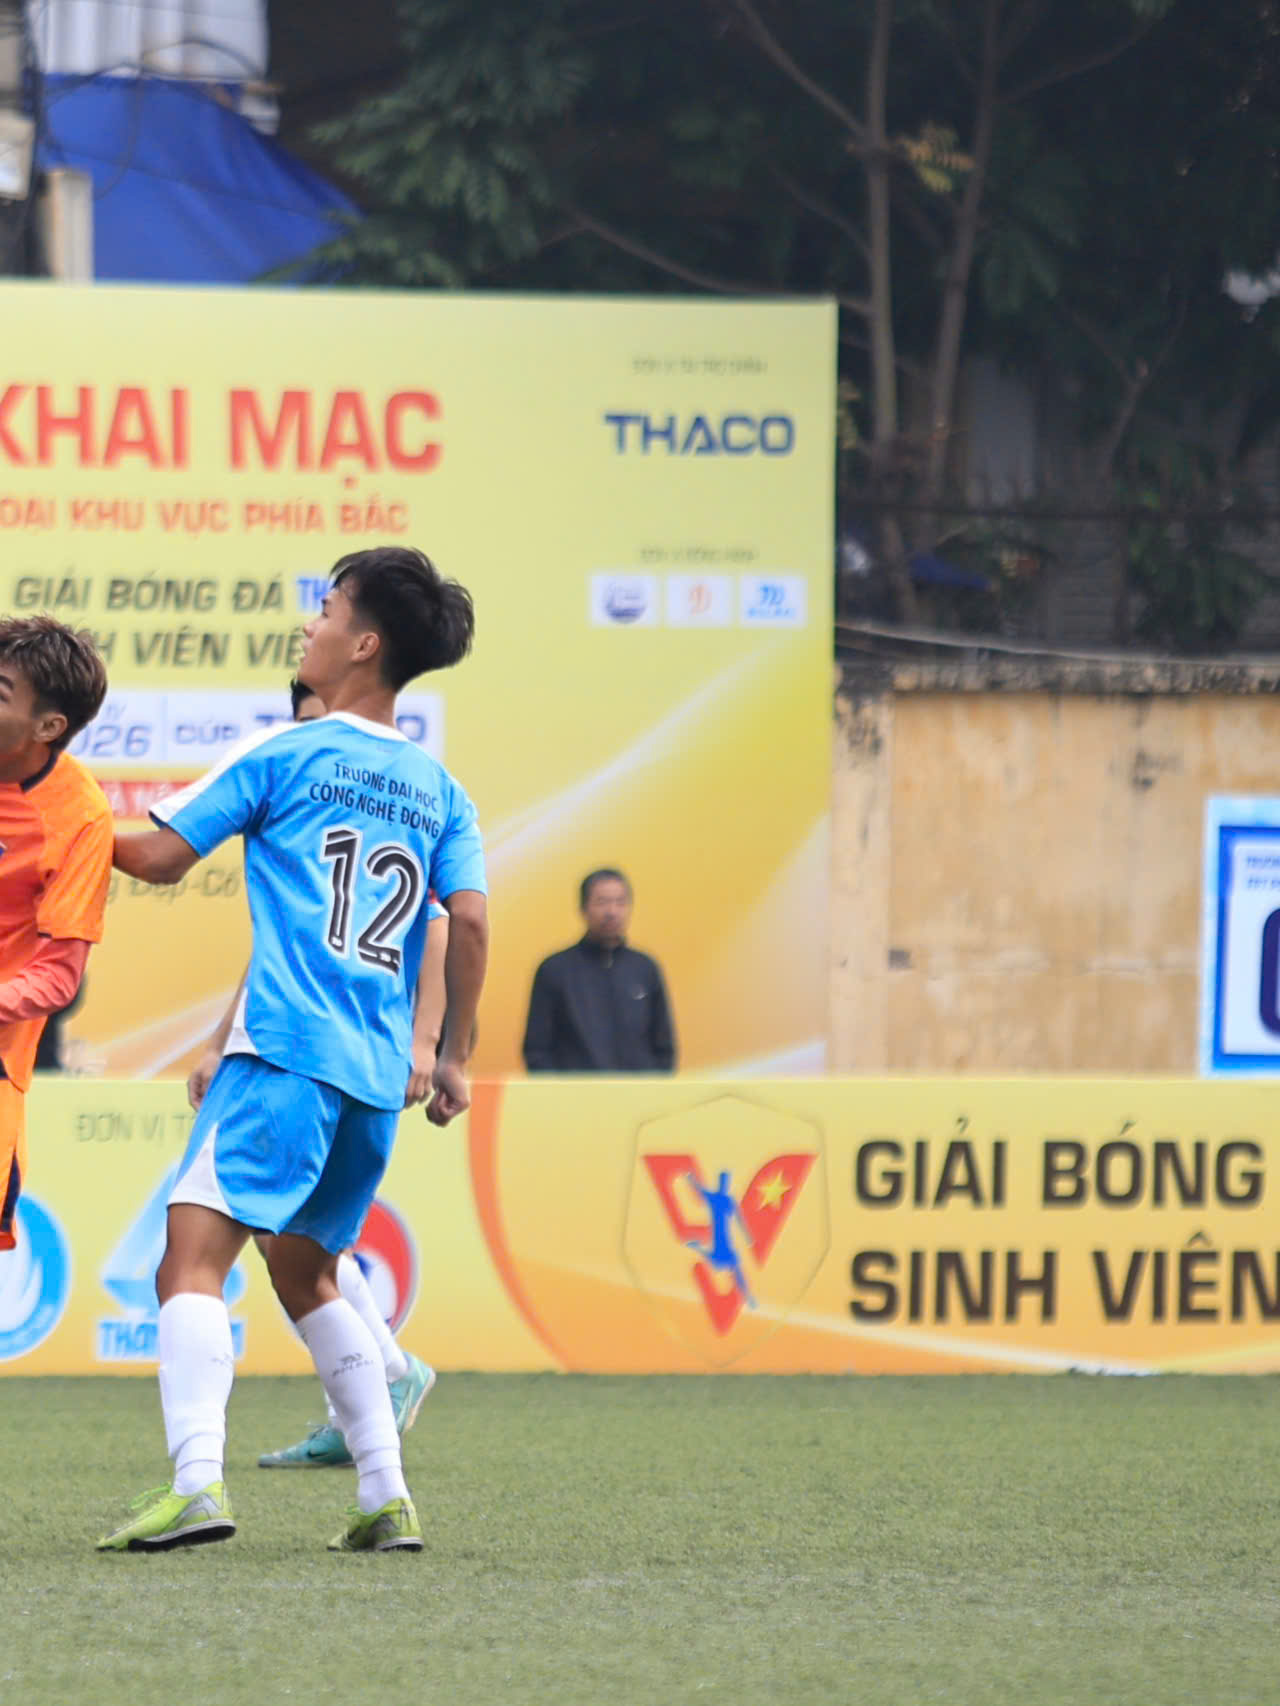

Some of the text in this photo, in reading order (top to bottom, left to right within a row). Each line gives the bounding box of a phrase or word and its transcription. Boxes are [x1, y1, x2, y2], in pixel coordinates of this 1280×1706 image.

[229, 388, 443, 490] MẠC
[604, 411, 796, 457] THACO
[71, 497, 145, 532] KHU
[244, 497, 326, 533] PHÍA
[106, 570, 218, 613] BÓNG
[232, 573, 284, 615] ĐÁ
[132, 625, 230, 669] VIÊN
[309, 780, 355, 809] CÔNG
[356, 791, 396, 827] NGHỆ
[320, 823, 424, 978] 12
[854, 1115, 1266, 1210] GIẢI BÓNG
[849, 1230, 1280, 1325] SINH VIÊN
